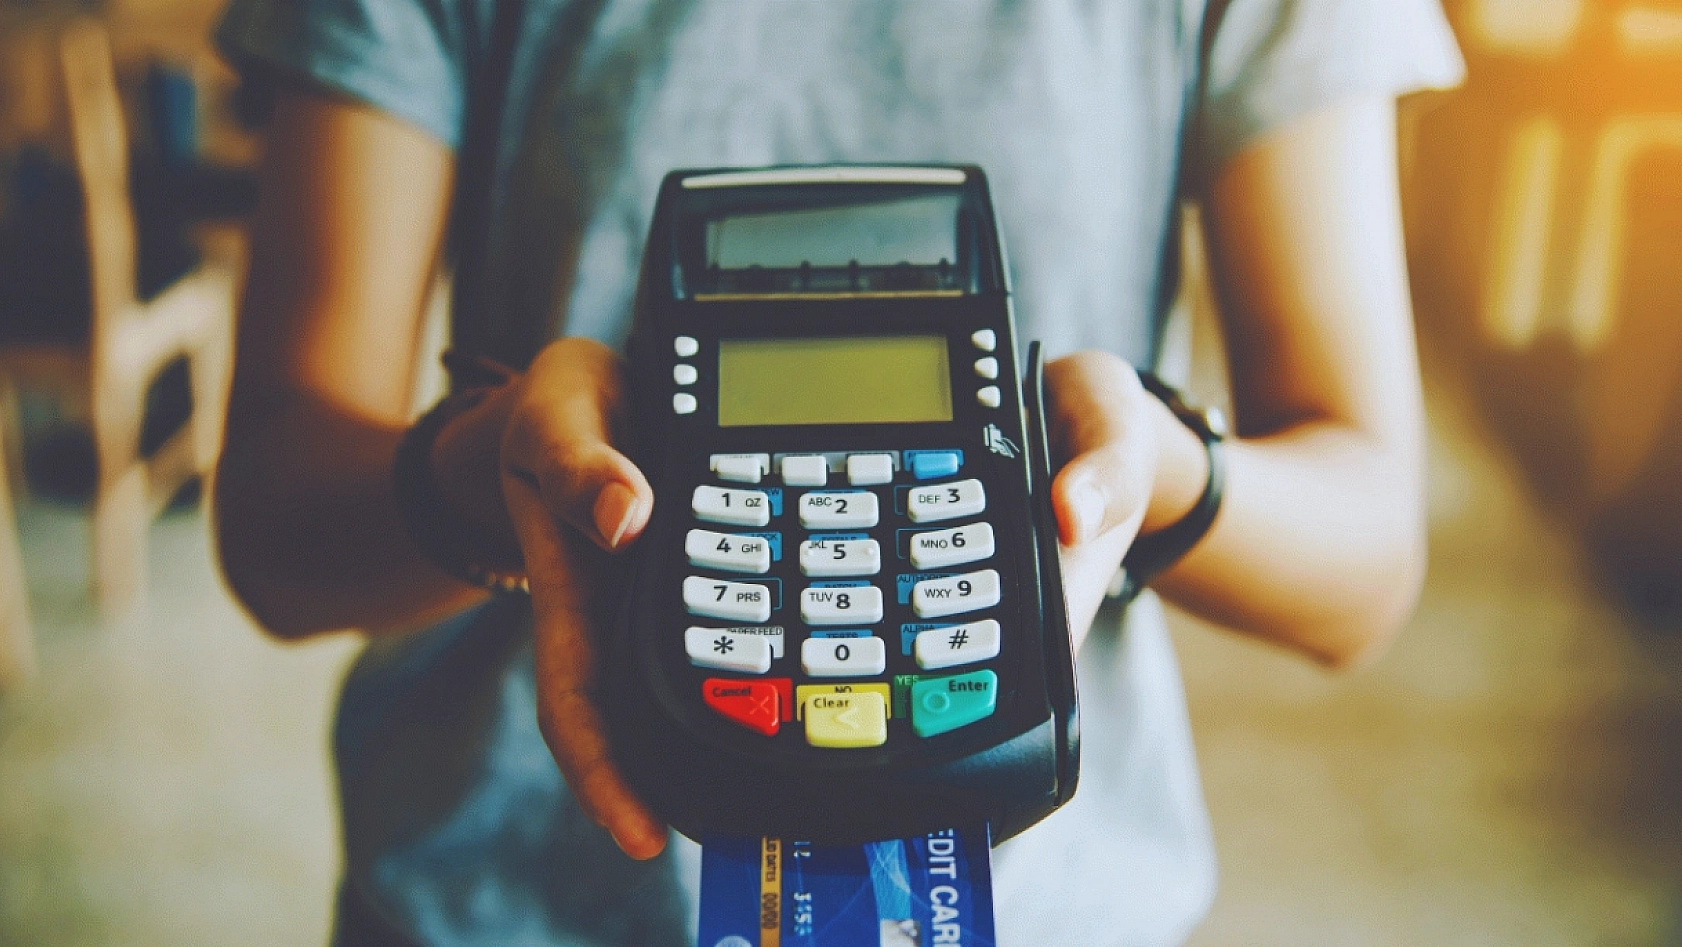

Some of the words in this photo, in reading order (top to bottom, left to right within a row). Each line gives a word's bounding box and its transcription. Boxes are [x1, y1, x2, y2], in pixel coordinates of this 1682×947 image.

[721, 492, 731, 507] 1
[745, 497, 761, 507] QZ
[917, 493, 941, 504] DEF
[947, 488, 961, 503] 3
[808, 496, 832, 506] ABC
[835, 499, 848, 514] 2
[716, 538, 731, 553] 4
[741, 543, 762, 553] GHI
[920, 539, 948, 549] MNO
[952, 532, 966, 548] 6
[808, 540, 828, 549] JKL
[833, 544, 846, 560] 5
[713, 585, 728, 602] 7
[737, 591, 761, 603] PRS
[924, 588, 952, 599] WXY
[957, 580, 972, 596] 9
[809, 591, 834, 602] TUV
[836, 593, 851, 609] 8
[835, 644, 850, 661] 0
[712, 686, 752, 697] Cancel
[949, 680, 989, 692] Enter
[813, 697, 849, 708] Clear
